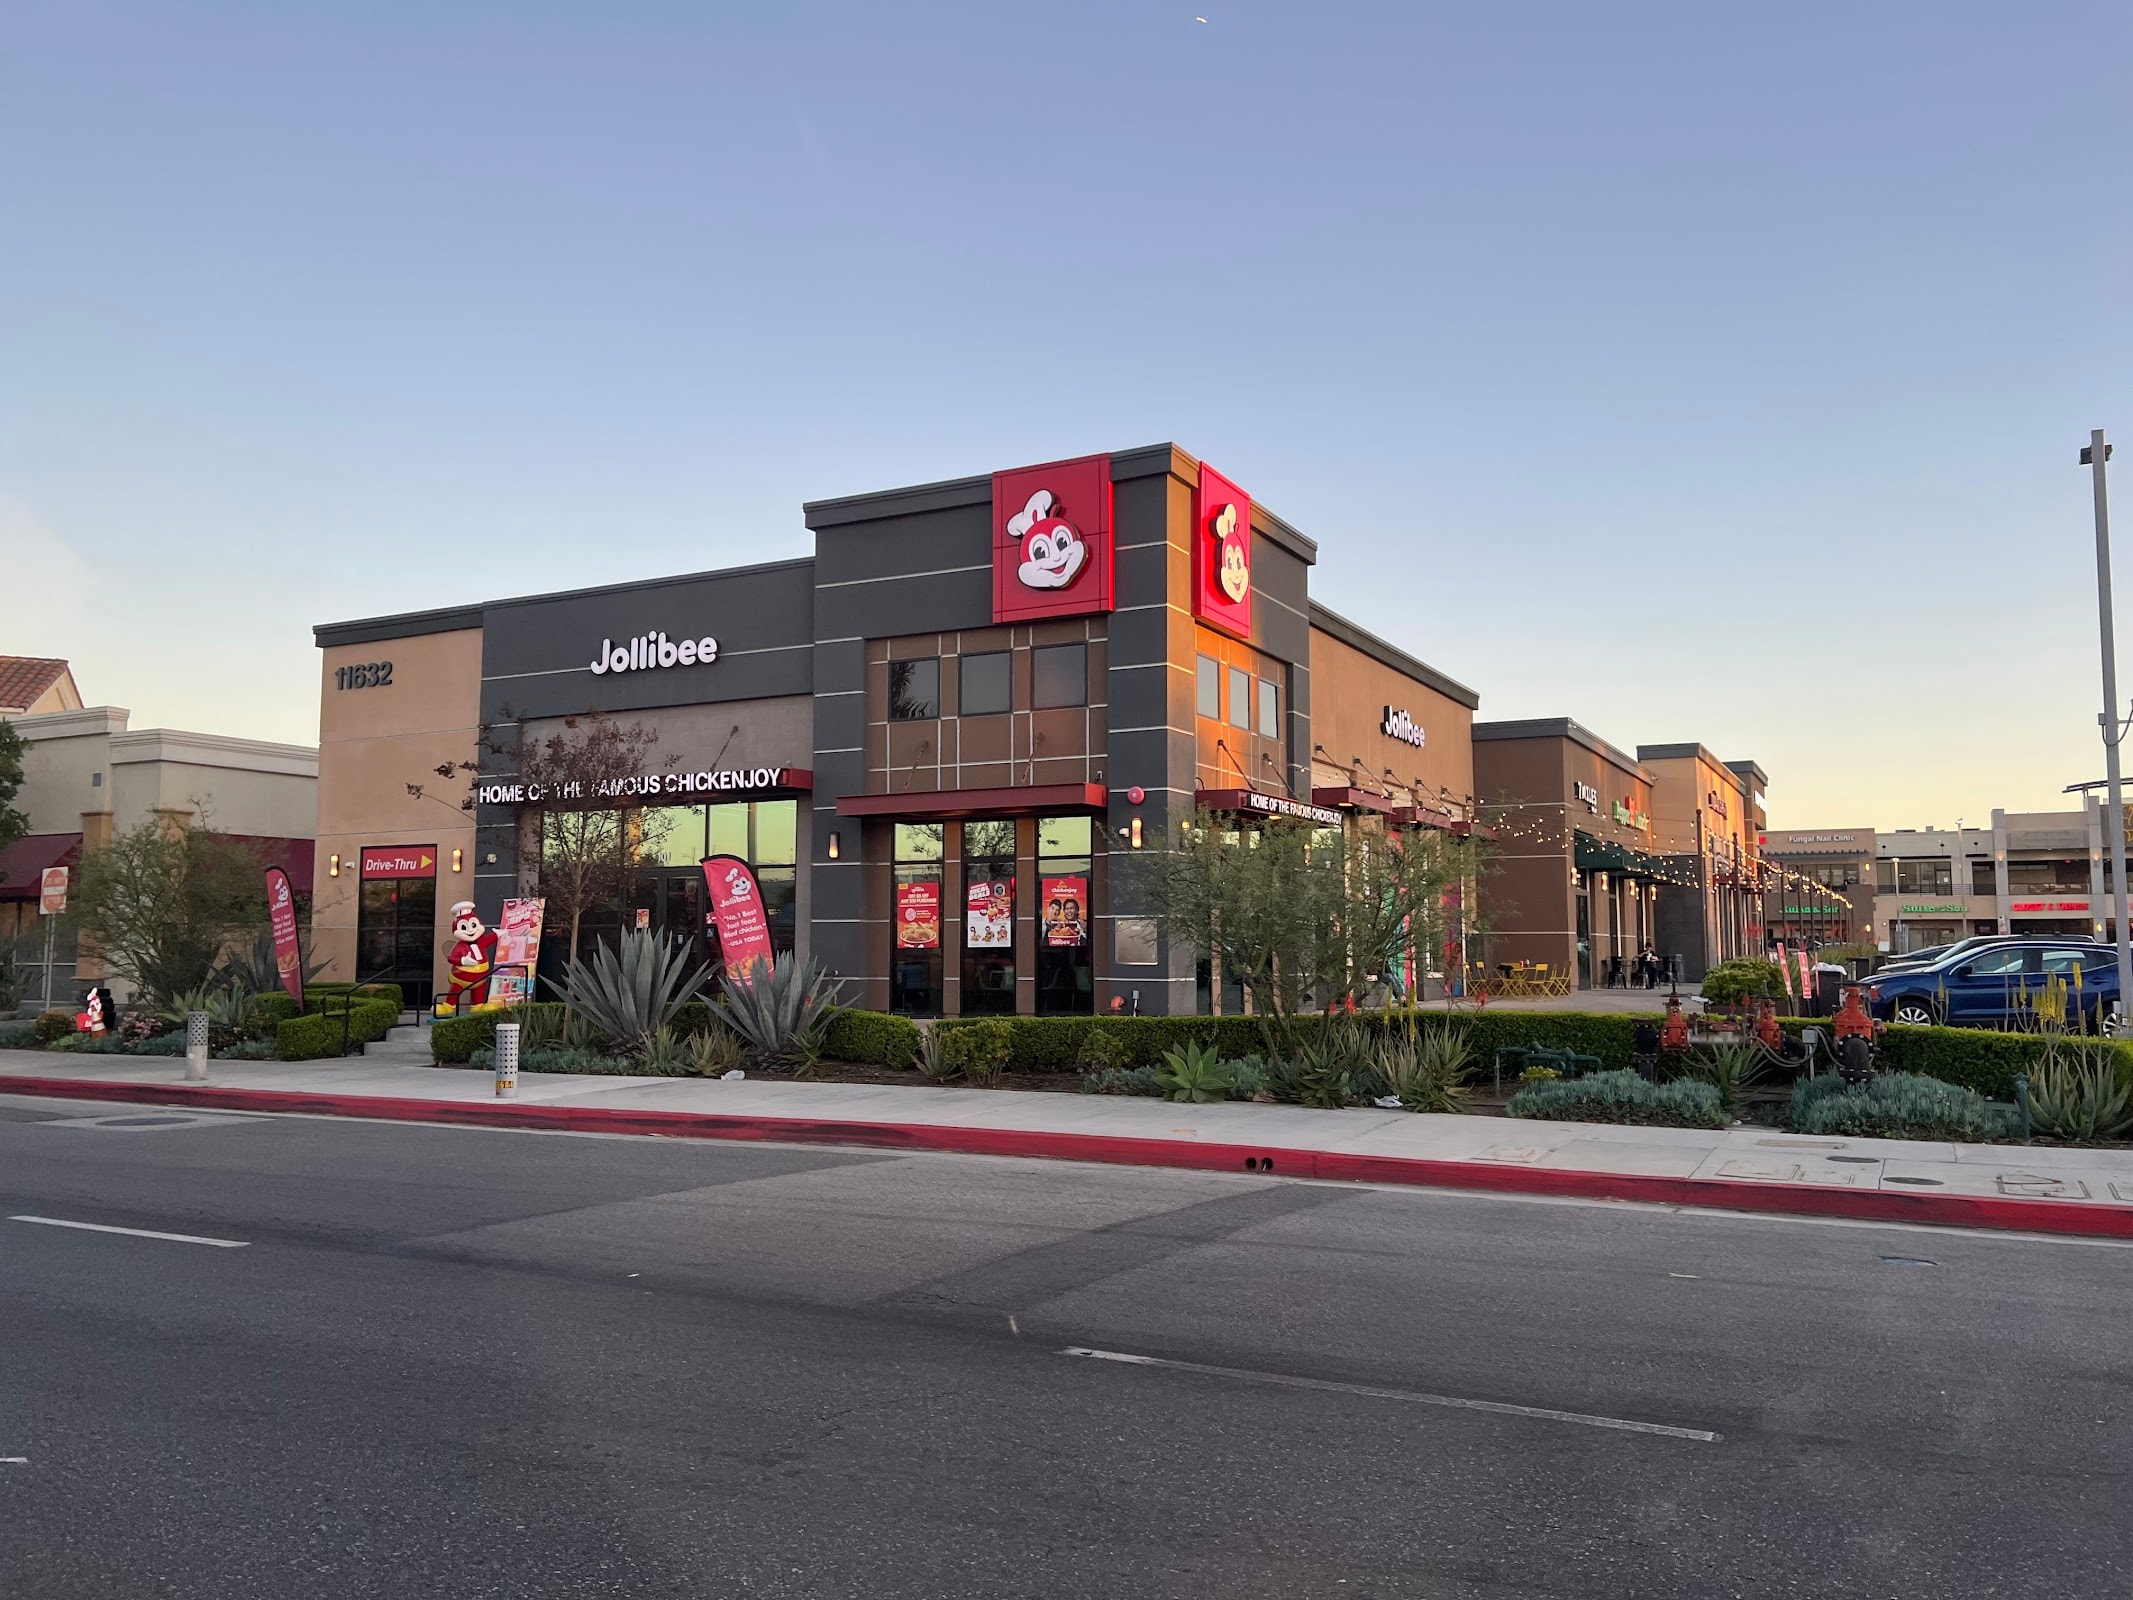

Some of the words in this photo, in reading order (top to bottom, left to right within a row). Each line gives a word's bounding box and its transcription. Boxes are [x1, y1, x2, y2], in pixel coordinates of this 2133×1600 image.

[590, 630, 718, 675] Jollibee
[335, 661, 393, 690] 11632
[1384, 704, 1425, 748] Jollibee
[479, 784, 525, 804] HOME
[664, 767, 781, 793] CHICKENJOY
[1250, 793, 1269, 810] HOME
[1269, 797, 1278, 812] OF
[1278, 799, 1290, 815] THE
[1788, 835, 1815, 844] Fungal
[1833, 834, 1855, 842] Clinic
[365, 858, 417, 871] Drive-Thru
[720, 894, 752, 908] Jollibee
[742, 908, 757, 918] Best
[727, 920, 740, 930] fast
[741, 917, 757, 927] food
[723, 929, 738, 939] fried
[744, 934, 764, 944] TODAY
